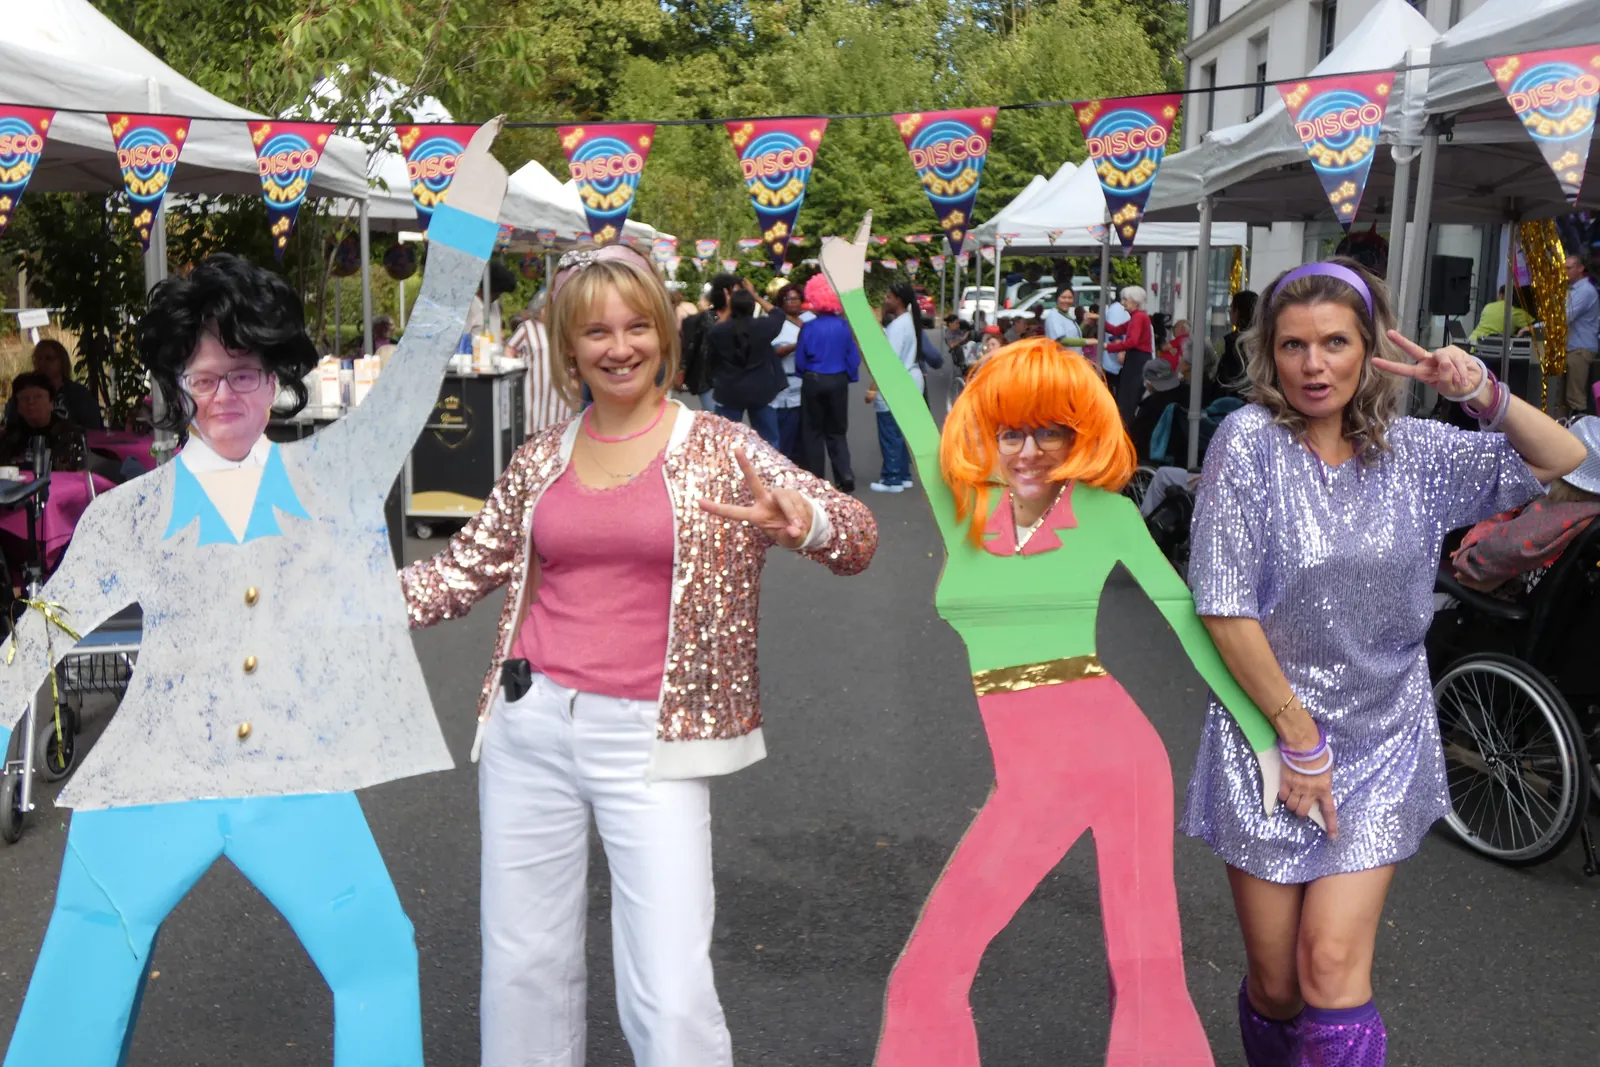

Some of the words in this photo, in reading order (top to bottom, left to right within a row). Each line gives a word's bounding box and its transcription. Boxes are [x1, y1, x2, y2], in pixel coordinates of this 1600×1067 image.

[1507, 74, 1600, 113] DISCO
[1295, 103, 1381, 142] DISCO
[1523, 106, 1593, 135] FEVER
[0, 134, 43, 155] SCO
[117, 143, 178, 169] DISCO
[909, 134, 987, 170] DISCO
[1086, 125, 1167, 159] DISCO
[1308, 135, 1374, 167] FEVER
[0, 160, 32, 183] VER
[257, 148, 318, 177] DISCO
[569, 152, 643, 182] DISCO
[741, 146, 813, 180] DISCO
[1098, 158, 1157, 188] FEVER
[124, 170, 169, 196] FEVER
[262, 176, 306, 202] FEVER
[580, 182, 634, 210] FEVER
[750, 177, 804, 207] FEVER
[921, 167, 979, 196] FEVER
